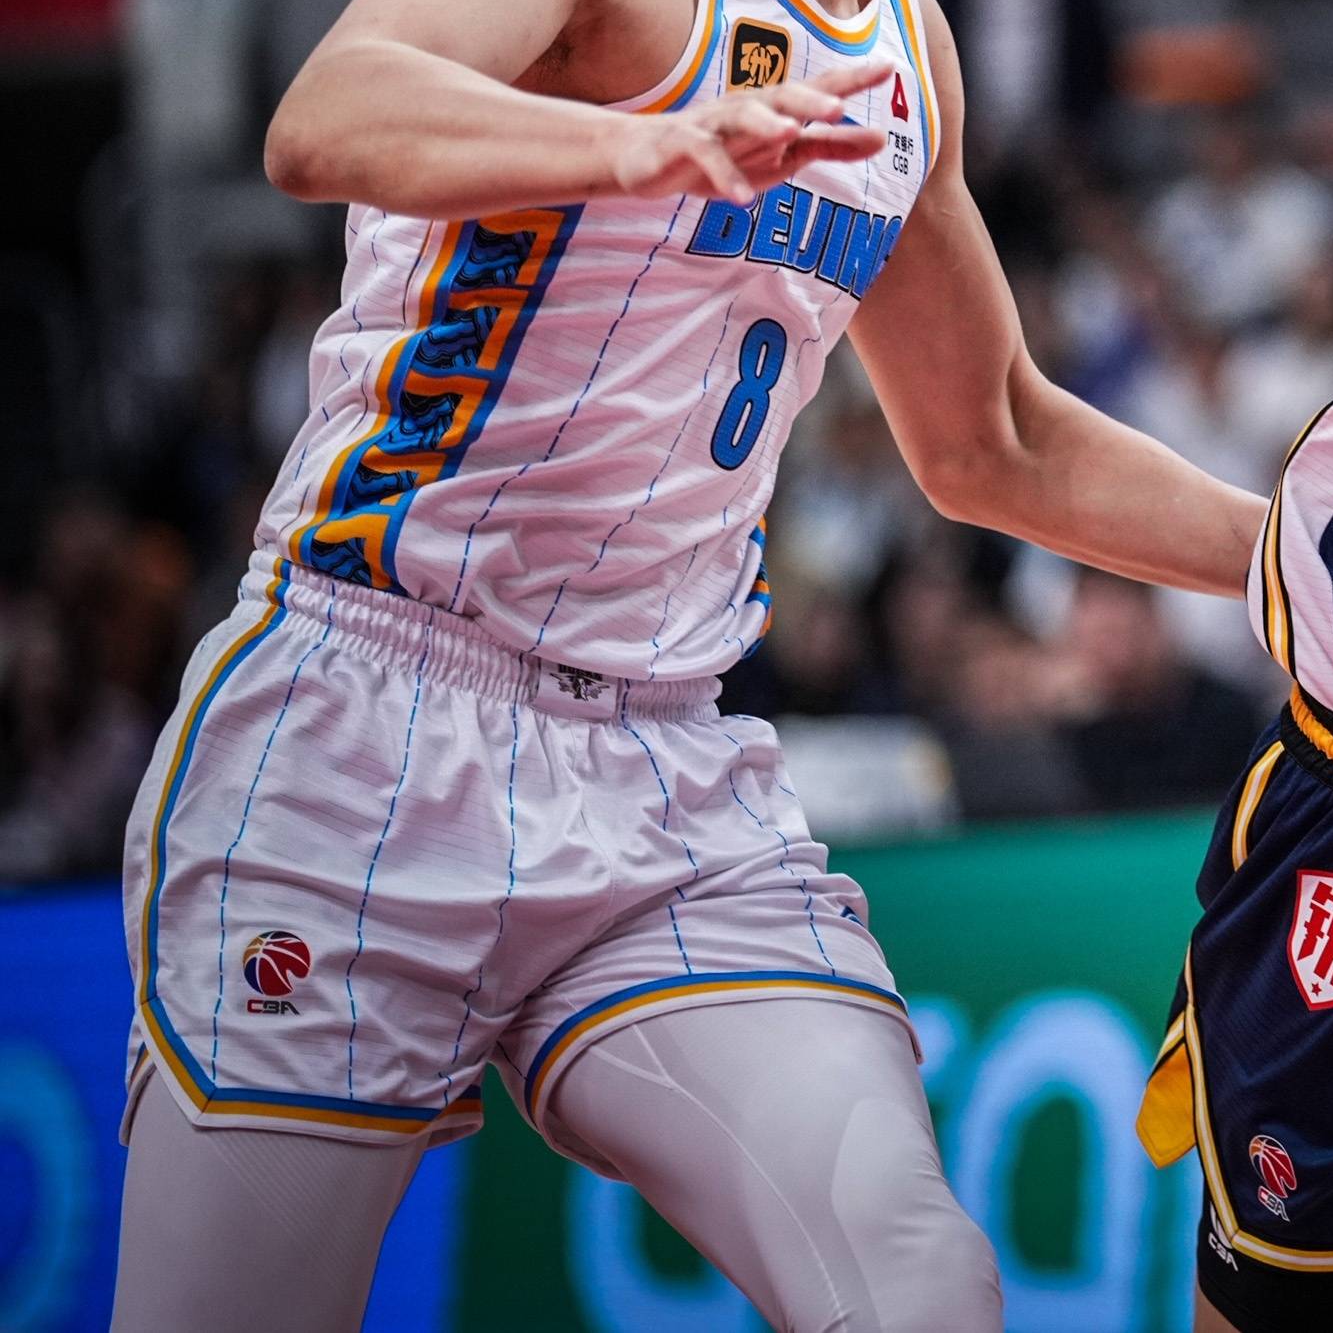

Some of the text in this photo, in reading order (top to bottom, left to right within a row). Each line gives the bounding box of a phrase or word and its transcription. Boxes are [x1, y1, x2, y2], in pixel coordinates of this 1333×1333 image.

[892, 153, 909, 176] CGB
[709, 317, 788, 472] 8
[247, 999, 300, 1016] CBA
[1258, 1185, 1291, 1222] CBA
[1208, 1232, 1239, 1272] CBA
